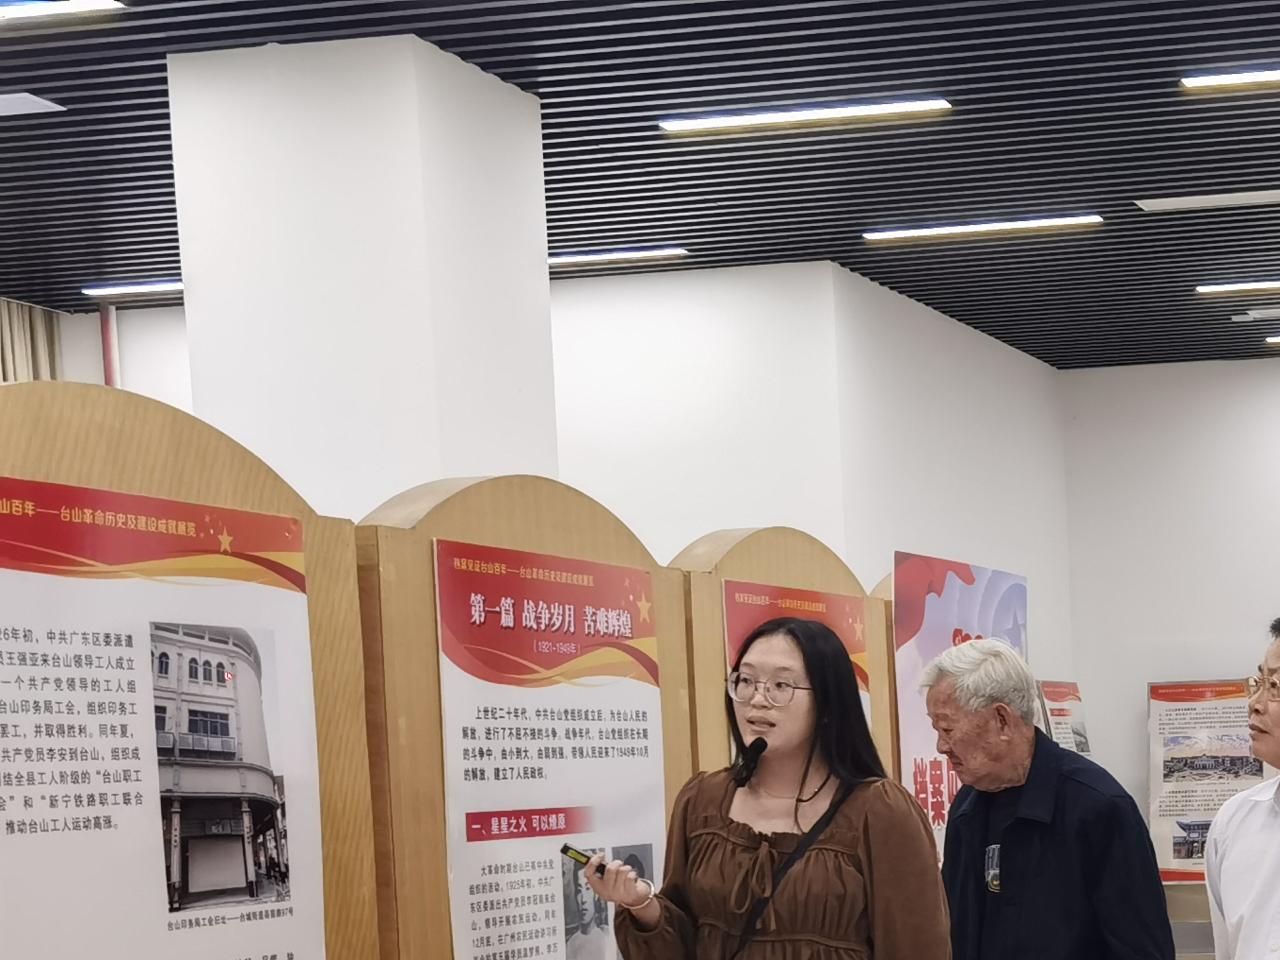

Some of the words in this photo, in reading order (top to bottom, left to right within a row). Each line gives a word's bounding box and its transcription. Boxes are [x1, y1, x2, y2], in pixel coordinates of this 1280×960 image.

[470, 592, 515, 629] 第一篇
[522, 599, 576, 634] 战争岁月
[582, 605, 633, 639] 苦难辉煌
